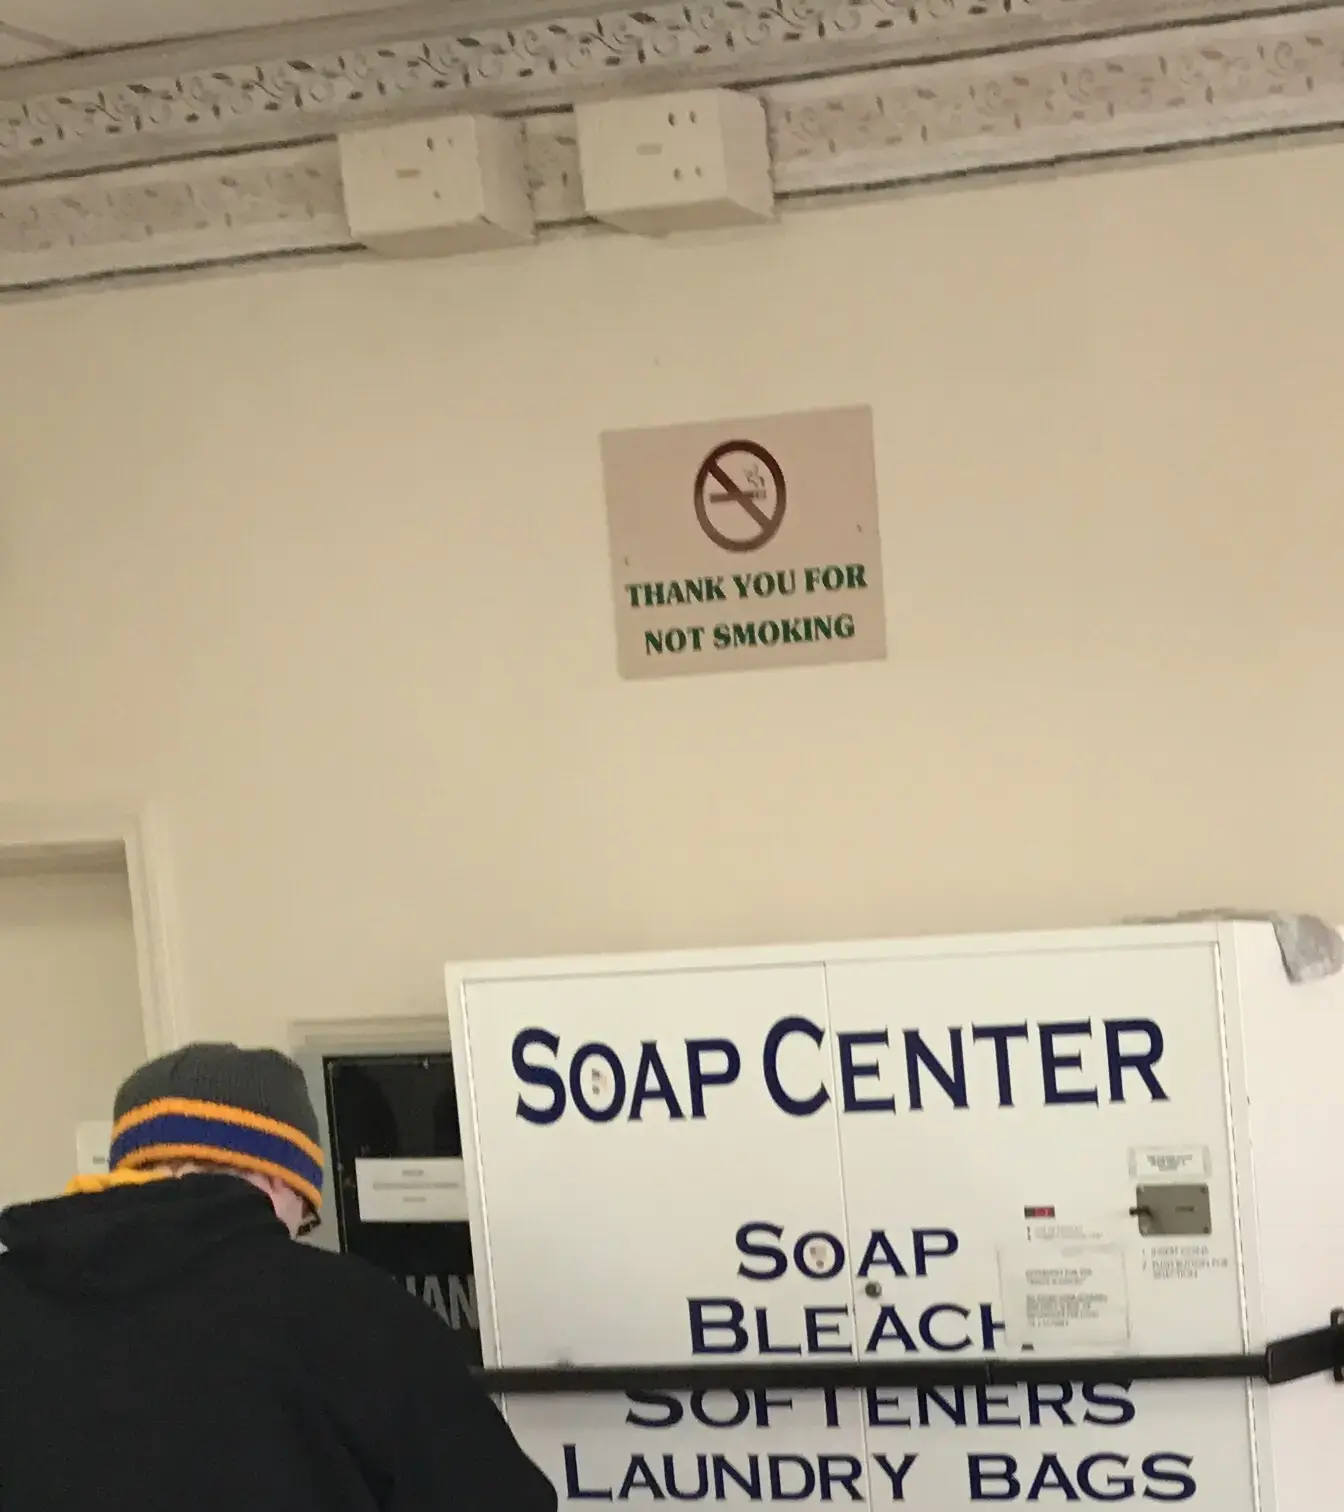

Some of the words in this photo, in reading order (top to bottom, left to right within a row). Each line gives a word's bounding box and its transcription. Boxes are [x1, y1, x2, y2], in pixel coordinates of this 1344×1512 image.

[625, 576, 727, 608] THANK
[731, 569, 797, 599] YOU
[803, 563, 868, 592] FOR
[644, 626, 704, 656] NOT
[713, 613, 855, 649] SMOKING
[511, 1026, 742, 1125] SOAP
[762, 1015, 1171, 1117] CENTER
[735, 1221, 960, 1281] SOAP
[562, 1443, 919, 1502] LAUNDRY
[967, 1453, 1198, 1502] BAGS
